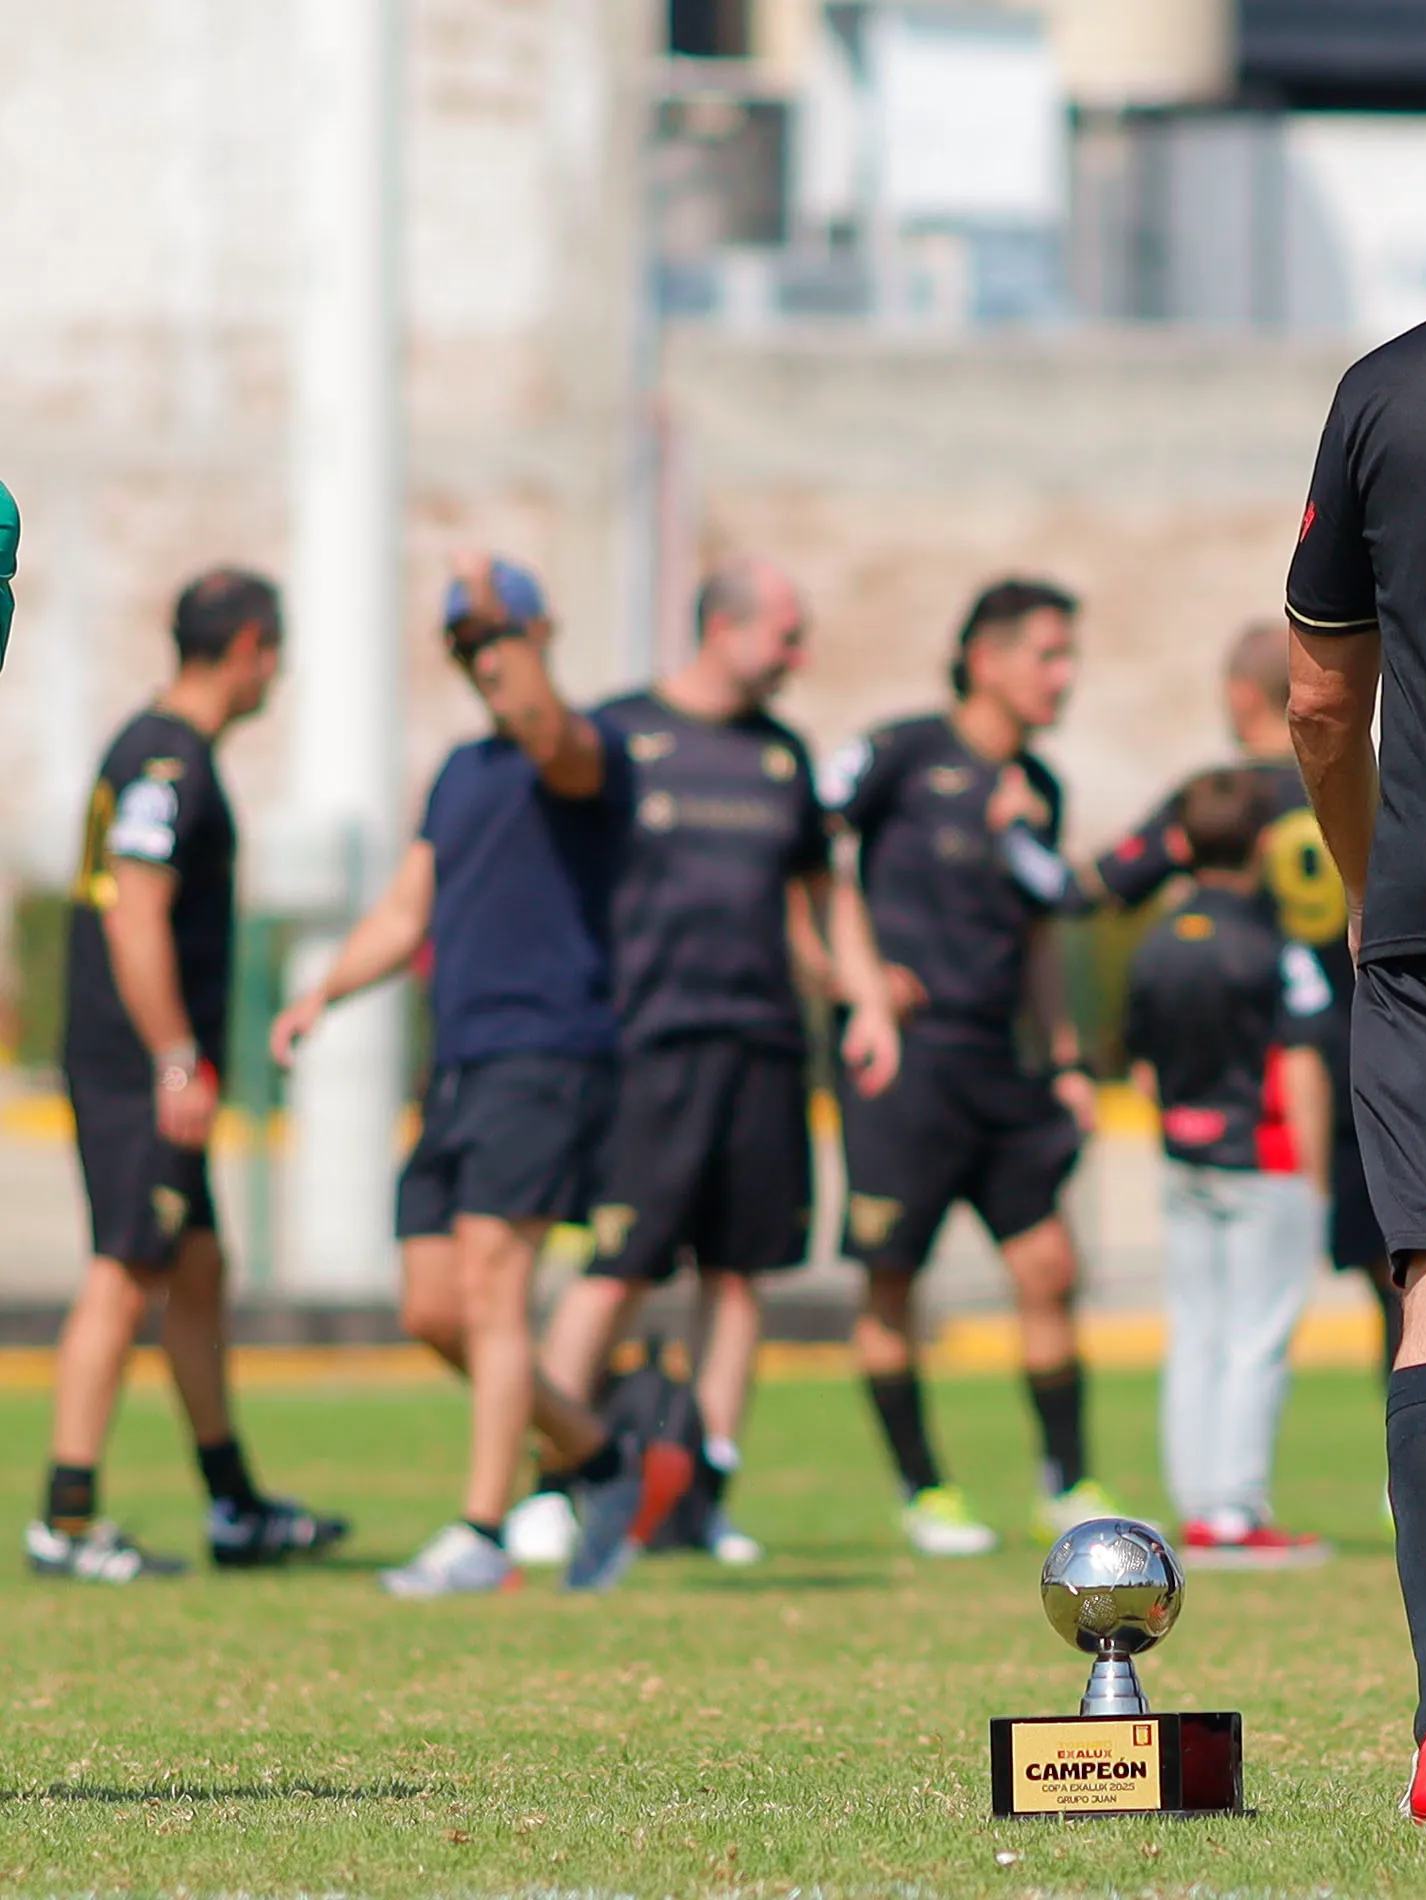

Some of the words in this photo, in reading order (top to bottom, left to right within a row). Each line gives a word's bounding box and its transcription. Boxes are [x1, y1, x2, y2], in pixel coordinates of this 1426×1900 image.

[1267, 810, 1347, 942] 9
[1057, 1749, 1112, 1759] EXALUX
[1025, 1757, 1147, 1781] CAMPEÓN
[1041, 1783, 1068, 1793] COPA
[1069, 1783, 1108, 1792] EXALUX
[1109, 1782, 1135, 1792] 2025
[1057, 1795, 1089, 1805] GRUPO
[1091, 1794, 1117, 1804] JUAN
